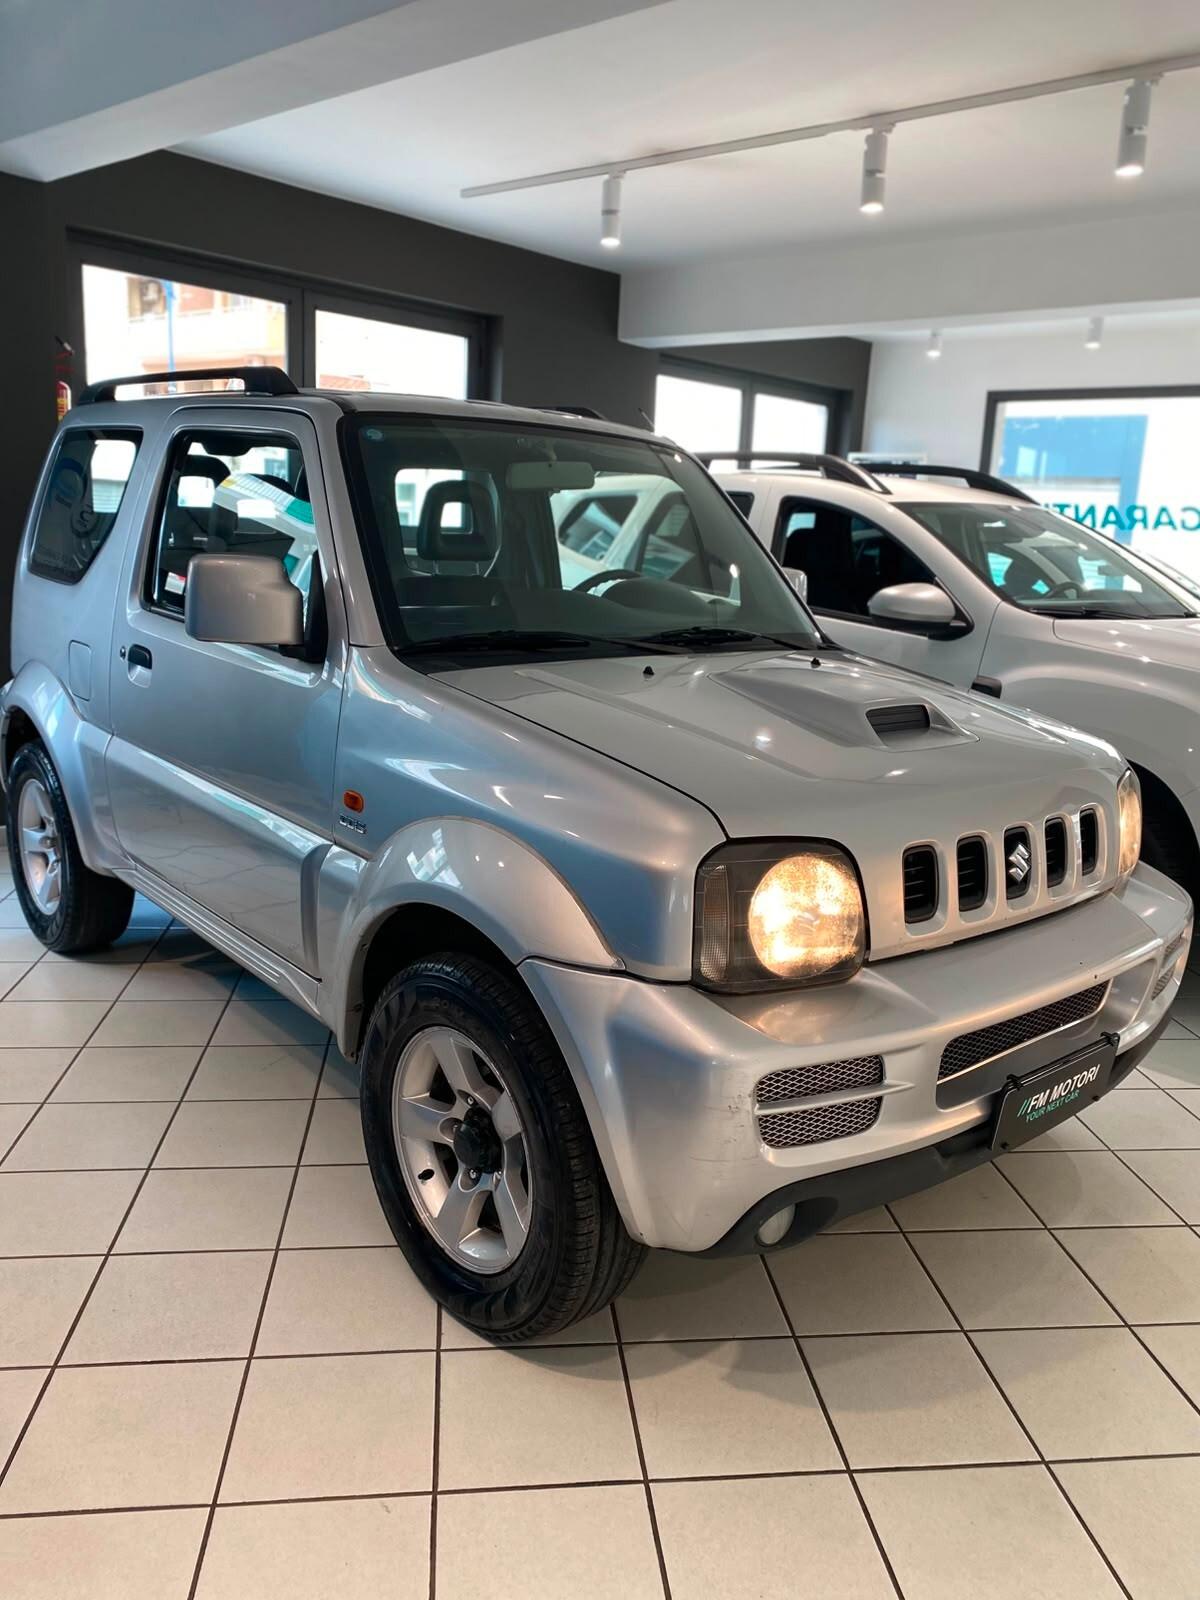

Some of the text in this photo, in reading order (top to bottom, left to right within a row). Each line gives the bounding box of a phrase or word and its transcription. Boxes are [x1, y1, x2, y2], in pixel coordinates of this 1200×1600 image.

[1049, 1064, 1100, 1102] MOTORI
[1026, 1089, 1081, 1123] YOUR NEXT CAR
